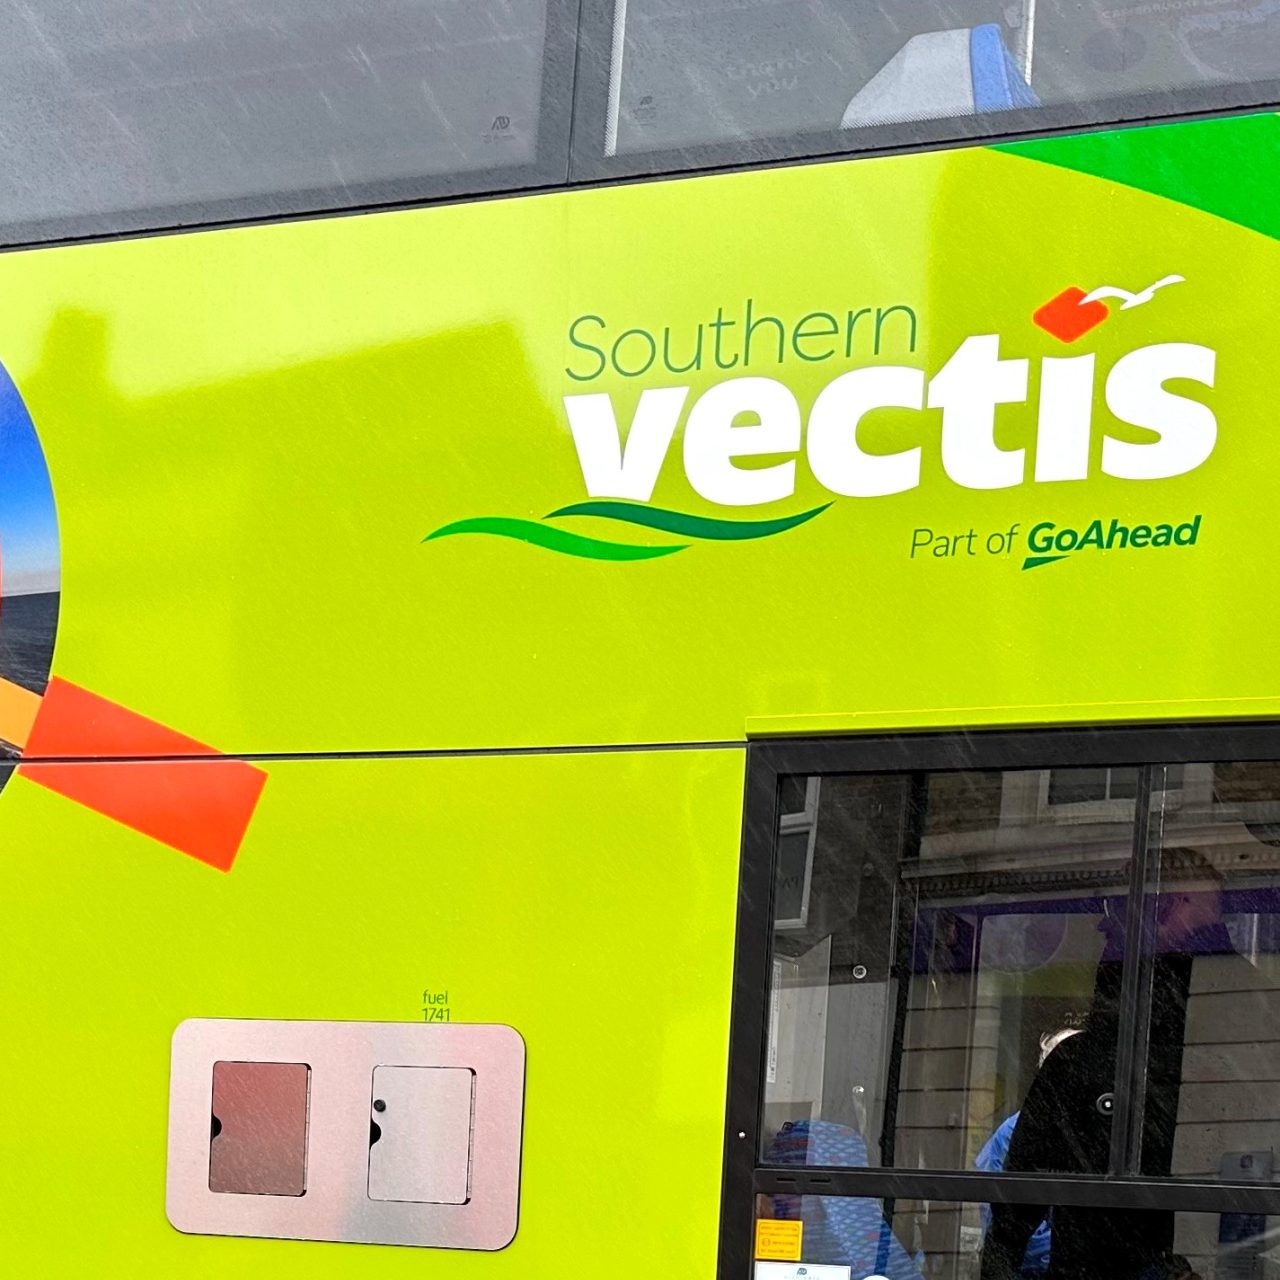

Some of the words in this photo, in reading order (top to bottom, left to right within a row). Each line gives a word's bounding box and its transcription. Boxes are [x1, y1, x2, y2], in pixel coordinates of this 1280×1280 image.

[566, 297, 917, 382] Southern
[563, 300, 1217, 506] vectis
[910, 528, 976, 559] Part
[987, 523, 1021, 555] of
[1023, 515, 1202, 560] GoAhead
[422, 1008, 450, 1021] 1741
[423, 989, 448, 1004] fuel
